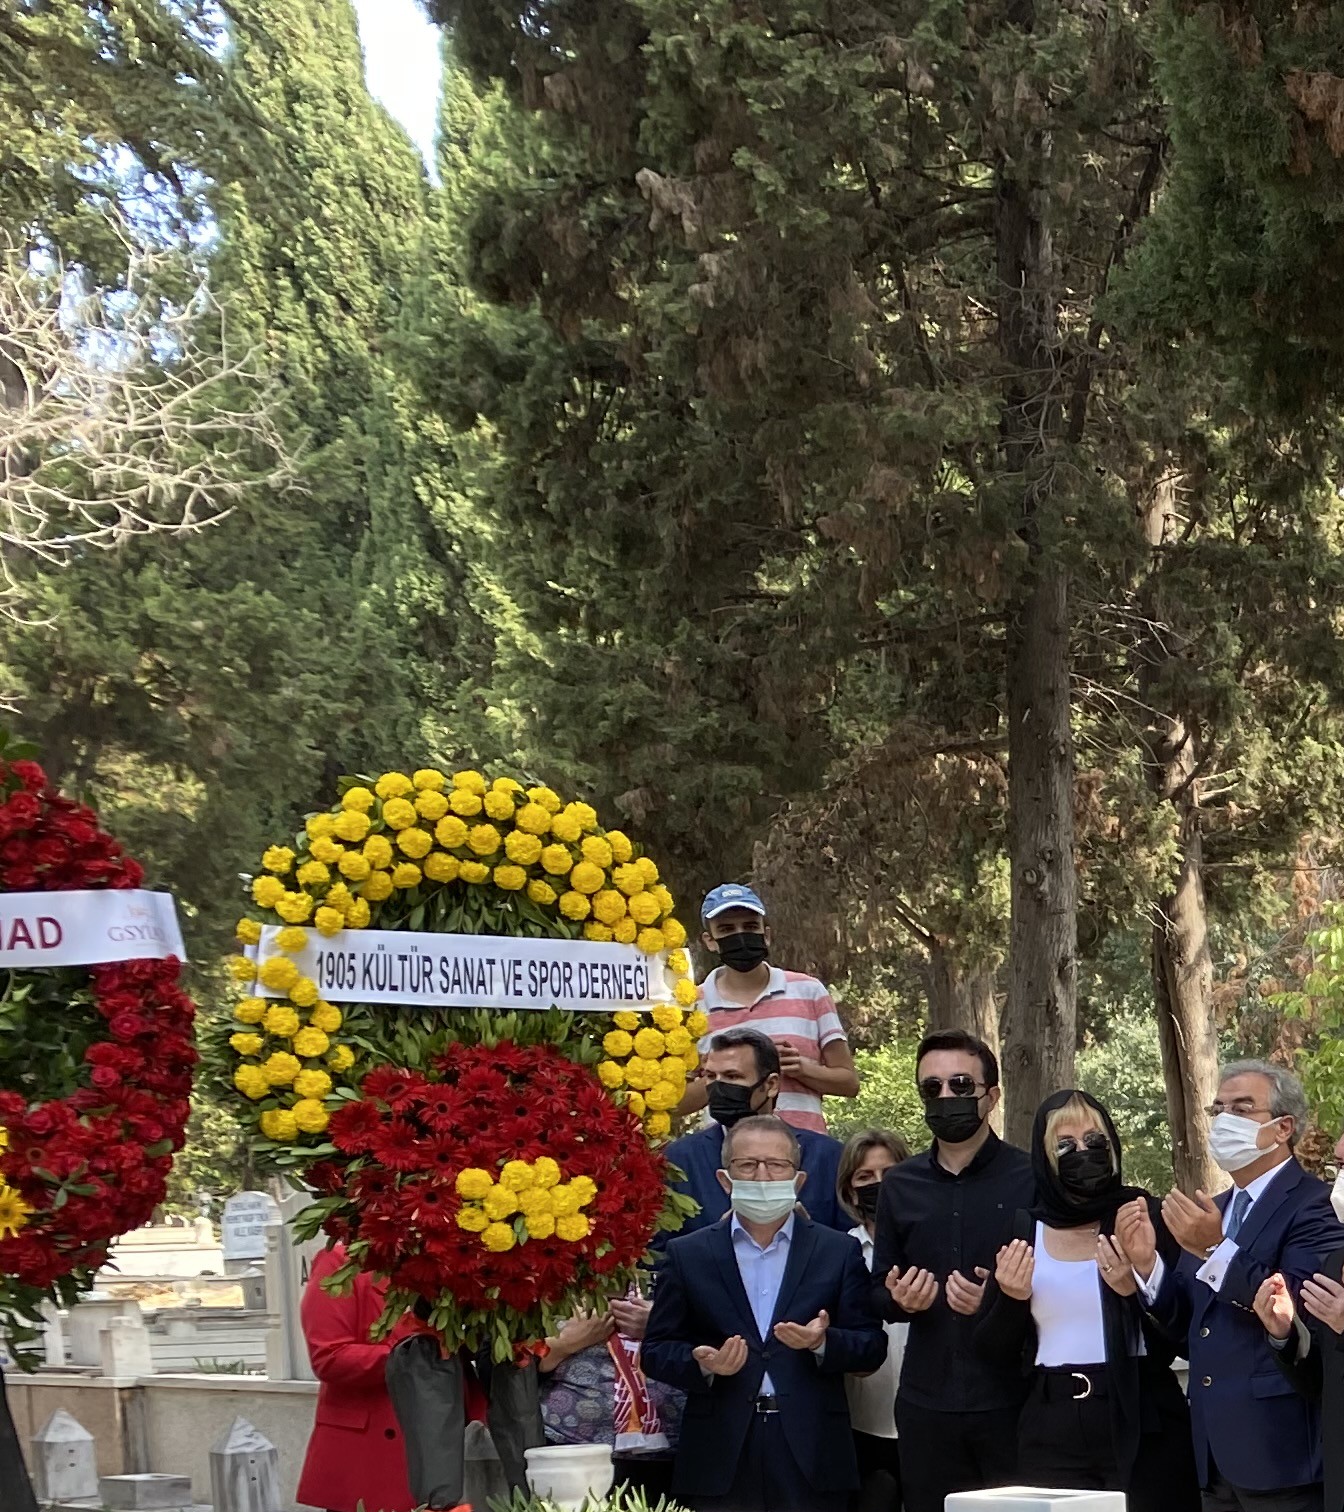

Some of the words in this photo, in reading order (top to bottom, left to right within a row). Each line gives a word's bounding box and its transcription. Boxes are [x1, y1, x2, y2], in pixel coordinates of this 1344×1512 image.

[0, 917, 63, 950] AD
[316, 951, 356, 990] 1905
[362, 944, 434, 993] KÜLTÜR
[439, 956, 496, 995] SANAT
[501, 959, 523, 996] VE
[528, 960, 574, 998] SPOR
[579, 954, 650, 1000] DERNEĞİ
